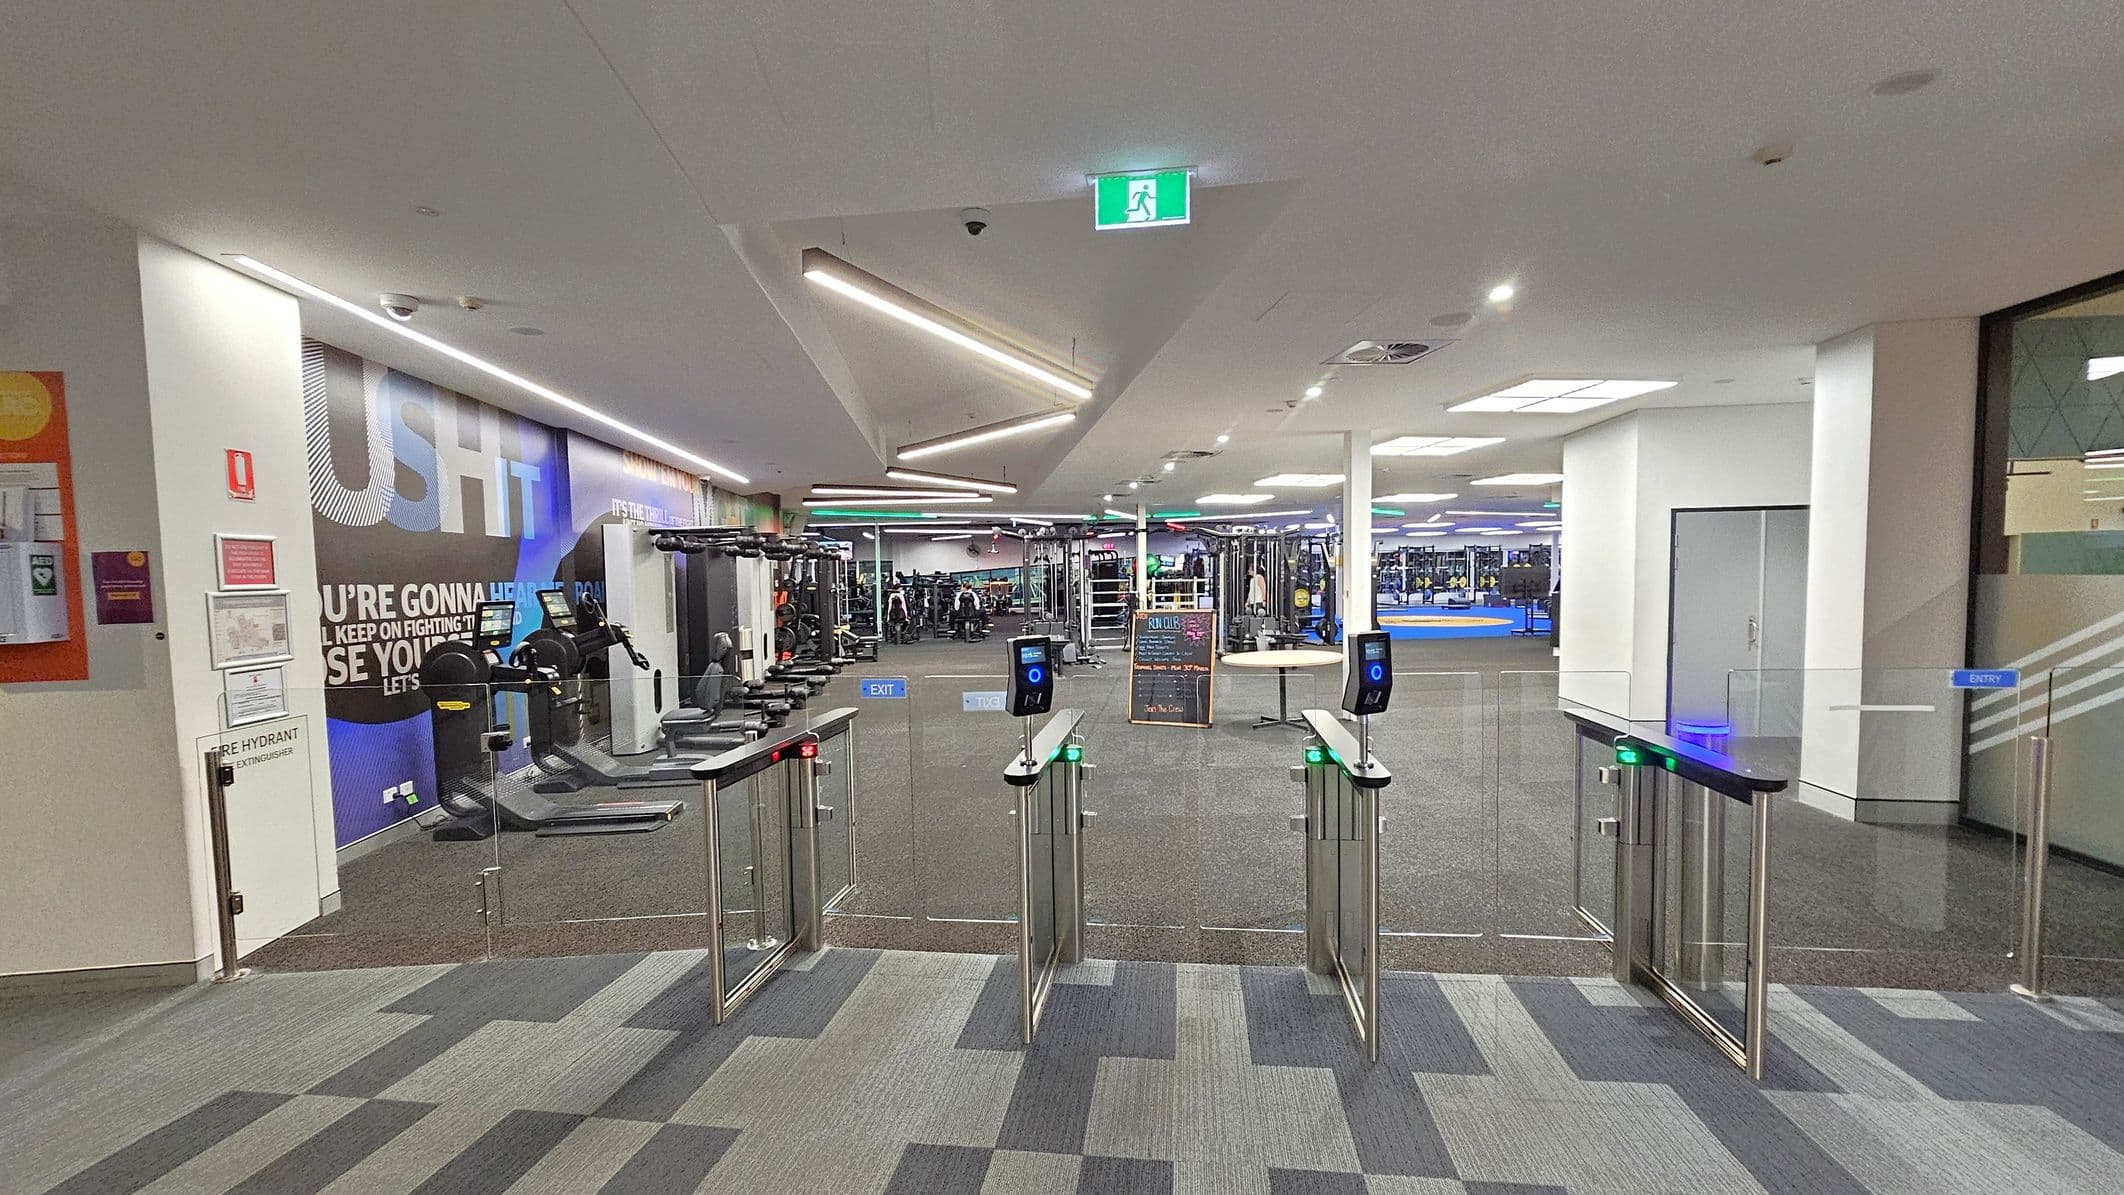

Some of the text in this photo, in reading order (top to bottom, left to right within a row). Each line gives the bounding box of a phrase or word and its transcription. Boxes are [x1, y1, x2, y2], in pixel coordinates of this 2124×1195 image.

[494, 456, 541, 540] IT
[628, 501, 645, 519] THE
[314, 583, 397, 623] U'RE
[401, 583, 485, 618] GONNA
[335, 624, 377, 645] KEEP
[379, 621, 402, 639] ON
[404, 616, 461, 637] FIGHTING
[322, 644, 369, 686] SE
[1969, 674, 2002, 683] ENTRY
[383, 672, 420, 697] LET'S
[870, 684, 894, 696] EXIT
[211, 727, 299, 758] IRE HYDRANT
[236, 747, 294, 769] EXTINGUISHER
